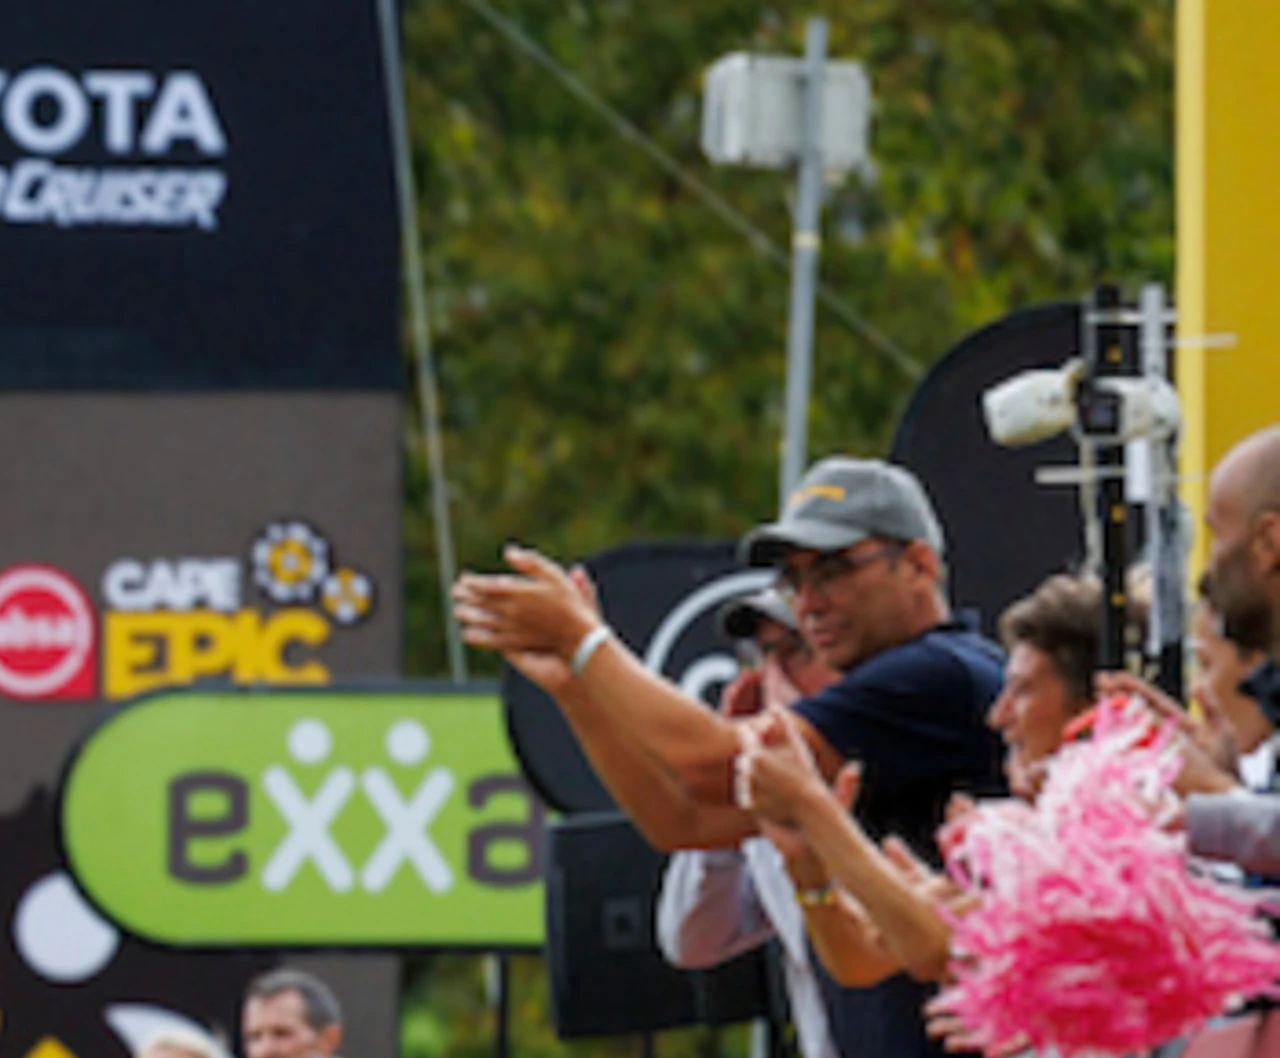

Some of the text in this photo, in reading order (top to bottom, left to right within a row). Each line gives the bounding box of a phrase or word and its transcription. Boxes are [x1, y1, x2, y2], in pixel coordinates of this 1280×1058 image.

[104, 559, 239, 609] CAPE
[102, 608, 330, 698] EPIC
[167, 718, 543, 893] exxa
